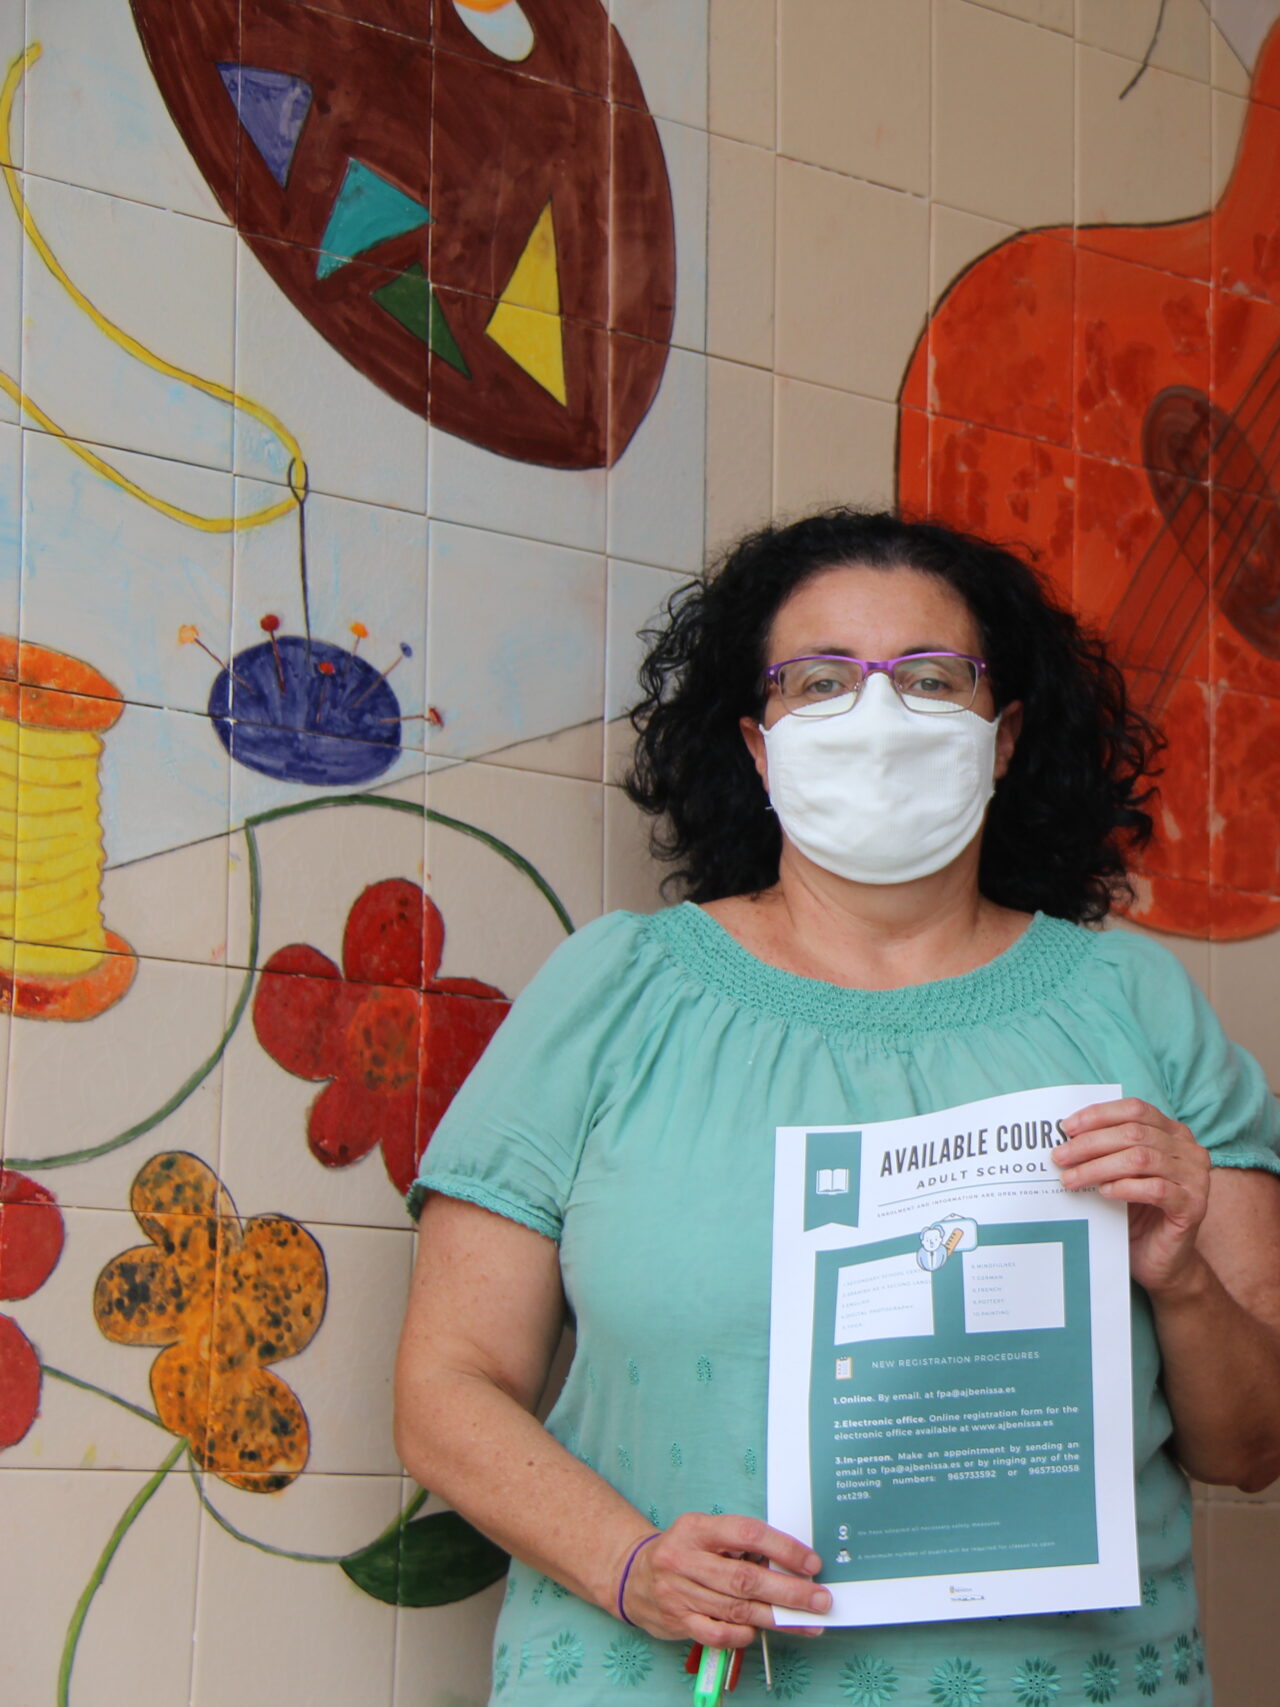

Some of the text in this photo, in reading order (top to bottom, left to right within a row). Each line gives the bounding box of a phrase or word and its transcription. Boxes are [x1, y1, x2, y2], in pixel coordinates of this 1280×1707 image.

[880, 1118, 1068, 1178] AVAILABLE COURS
[916, 1162, 1048, 1190] ADULT SCHOOL
[871, 1351, 1040, 1369] NEW REGISTRATION PROCEDURES
[877, 1393, 890, 1403] By
[924, 1390, 934, 1399] at
[936, 1386, 1016, 1399] fpa@ajbenissa.es
[928, 1413, 960, 1422] Online
[963, 1409, 1017, 1421] registration
[1020, 1407, 1043, 1416] form
[1046, 1406, 1060, 1414] for
[1062, 1405, 1078, 1413] the
[834, 1419, 1054, 1441] electronic office available at www.ajbenissa.es
[897, 1451, 923, 1460] Make
[944, 1445, 1005, 1458] appointment
[1009, 1444, 1021, 1454] by
[1025, 1441, 1063, 1451] sending
[835, 1452, 1080, 1477] email to fpa@ajbenissa.es or by ringing any of the
[836, 1464, 1080, 1489] following numbers: 965733592 or 965730058
[836, 1491, 871, 1501] ext299.
